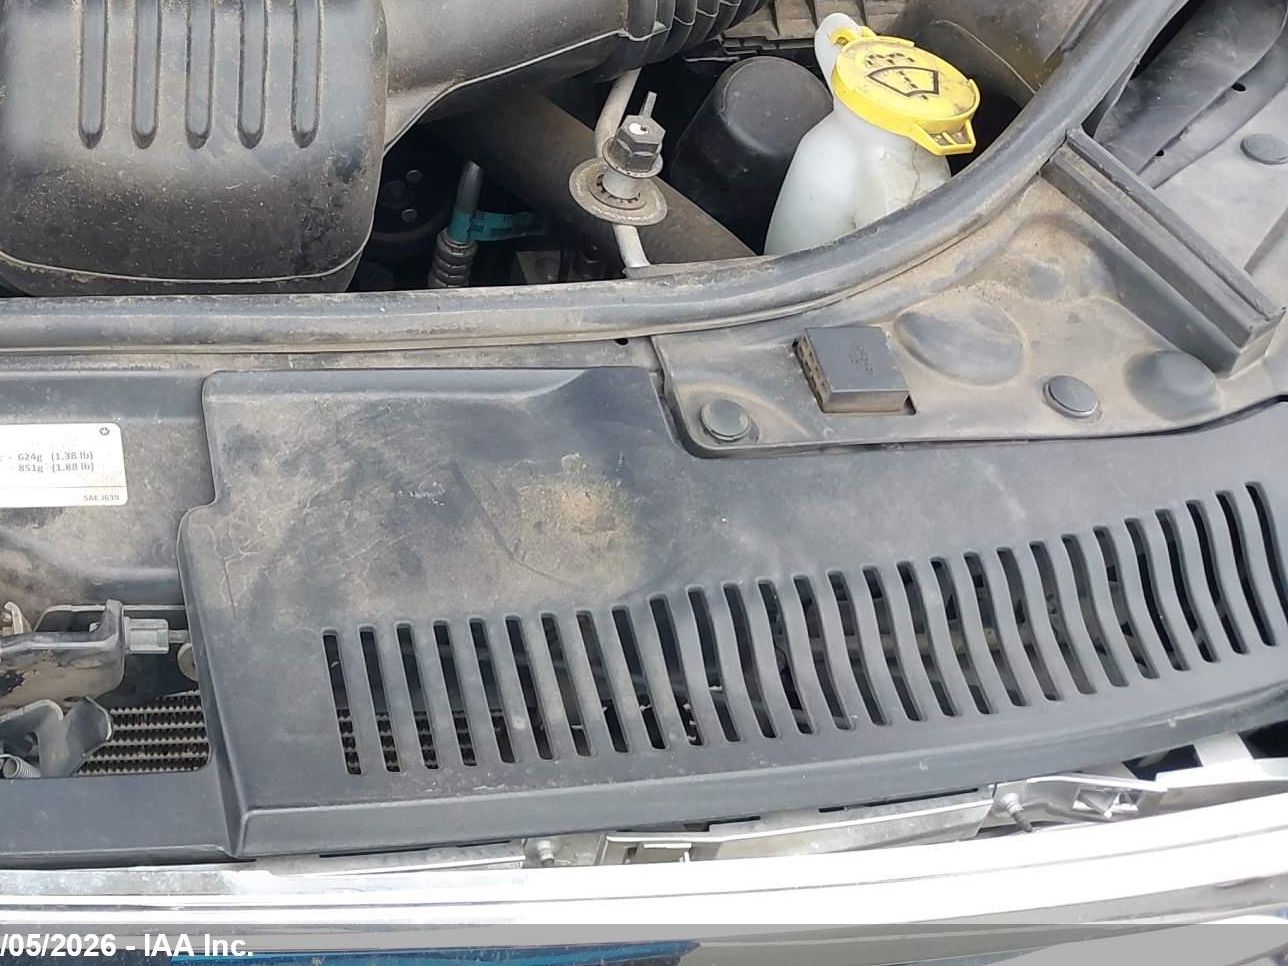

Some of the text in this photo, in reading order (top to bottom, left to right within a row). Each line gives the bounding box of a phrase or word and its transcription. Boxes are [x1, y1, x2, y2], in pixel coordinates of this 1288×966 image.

[17, 453, 43, 463] 624g
[51, 451, 78, 462] (1.38
[80, 450, 94, 461] lb)
[18, 464, 44, 474] 851g
[51, 463, 79, 474] (1.88
[81, 461, 95, 474] lb)
